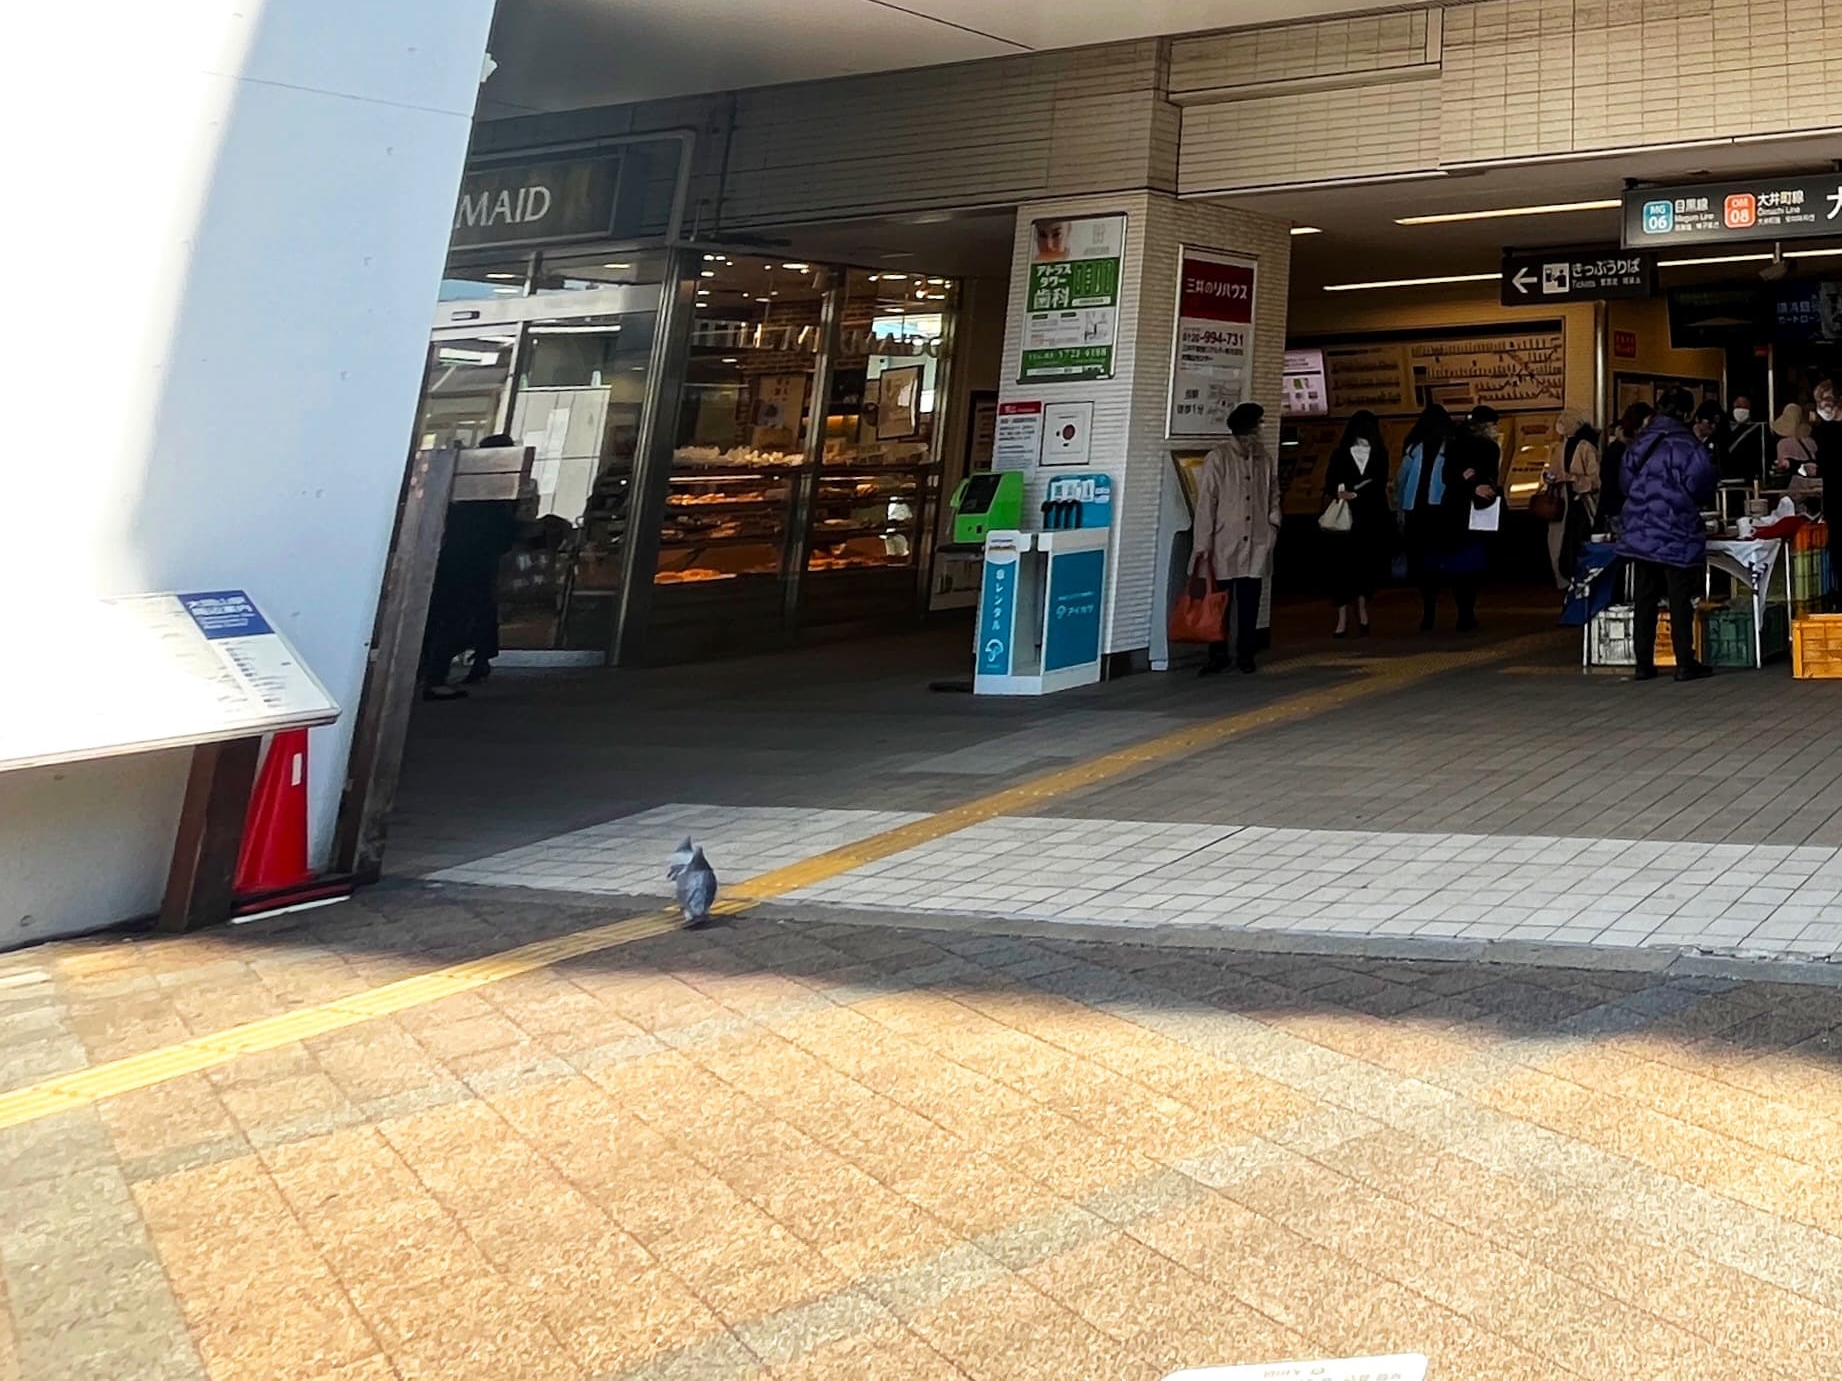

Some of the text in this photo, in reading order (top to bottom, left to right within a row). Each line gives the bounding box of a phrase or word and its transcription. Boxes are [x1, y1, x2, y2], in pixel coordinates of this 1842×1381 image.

[1674, 197, 1709, 214] 目黒線
[1731, 197, 1749, 208] OM
[1756, 189, 1805, 207] 大井町線
[1650, 204, 1667, 215] MG
[1730, 208, 1750, 224] 08
[1649, 215, 1668, 230] 06
[1036, 262, 1072, 277] アトラス
[1571, 257, 1641, 278] きっぷうりば
[1039, 276, 1068, 288] タワー
[1185, 277, 1249, 300] 三井のリハウス
[1033, 286, 1070, 310] 歯科
